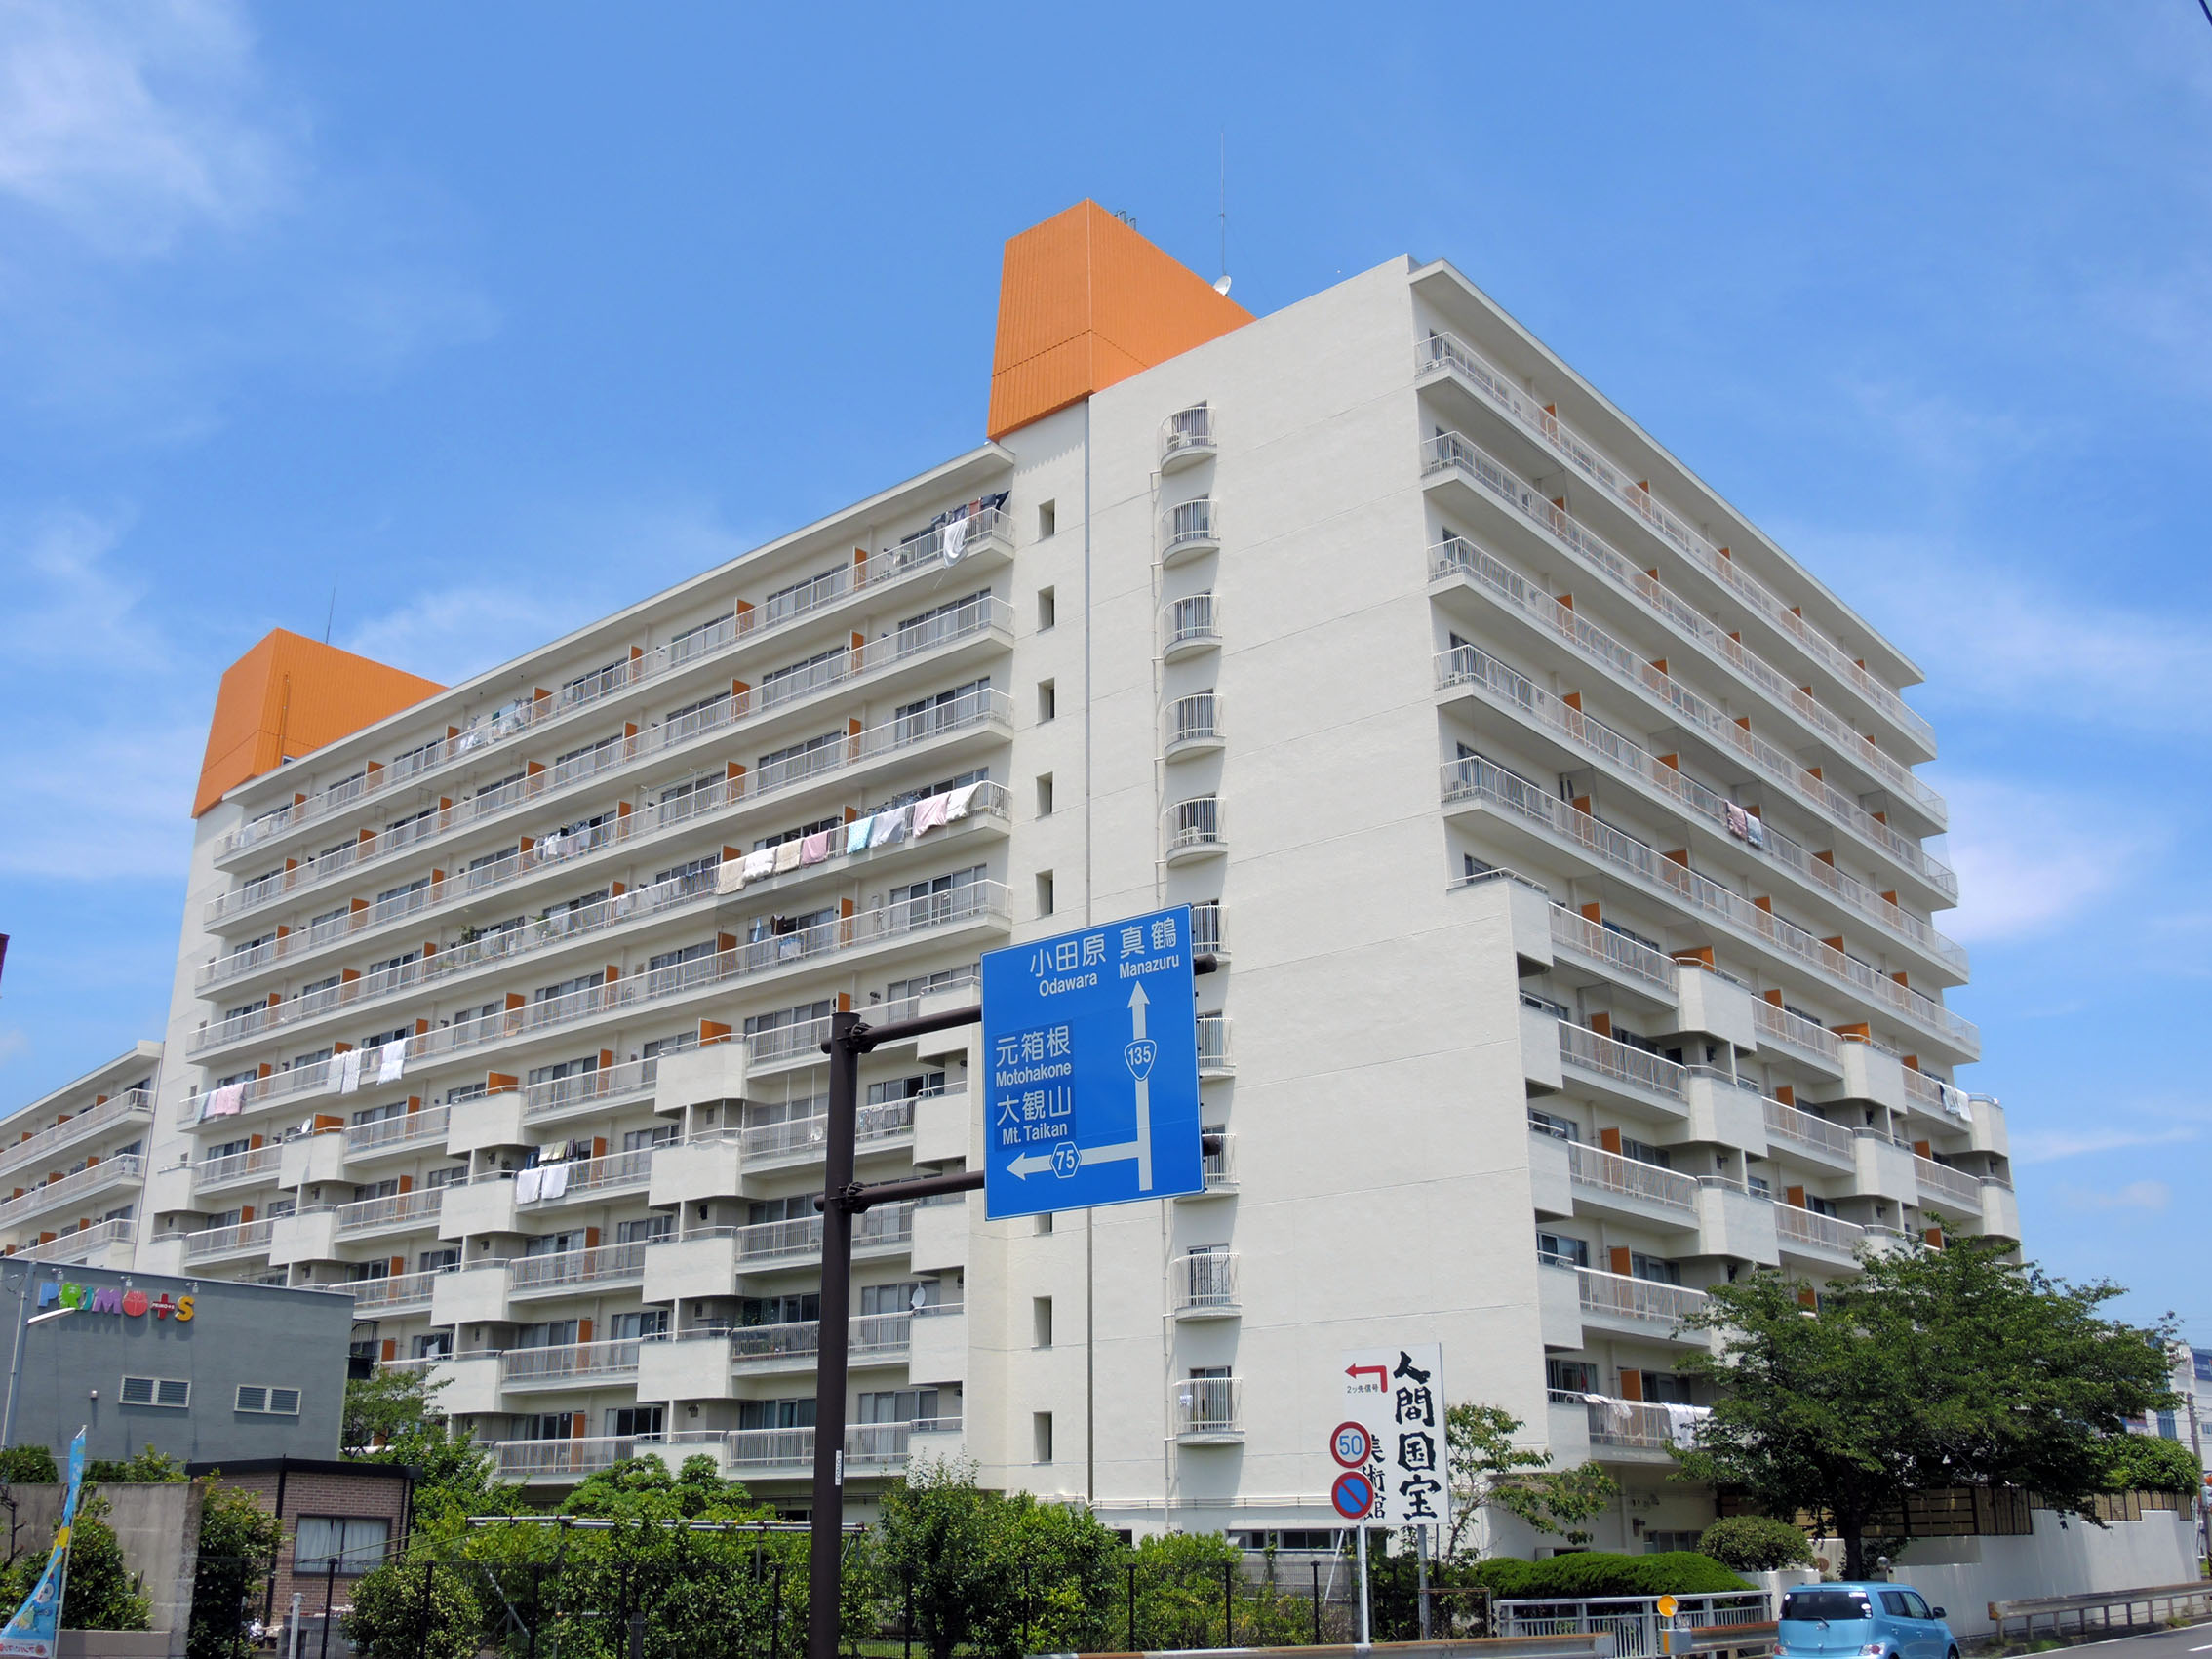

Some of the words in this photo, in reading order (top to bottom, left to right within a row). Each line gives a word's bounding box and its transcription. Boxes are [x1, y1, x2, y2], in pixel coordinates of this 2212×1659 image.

[1029, 932, 1106, 978] 小田原
[1120, 916, 1177, 959] 真鶴
[1039, 971, 1098, 997] Odawara
[1119, 954, 1180, 979] Manazuru
[995, 1025, 1071, 1069] 元箱根
[1128, 1045, 1152, 1066] 135
[995, 1062, 1072, 1088] Motohakone
[996, 1086, 1072, 1126] 大観山
[1002, 1127, 1022, 1145] Mt.
[1025, 1122, 1068, 1142] Taikan
[1056, 1149, 1076, 1171] 75
[1339, 1435, 1363, 1456] 50
[1393, 1350, 1442, 1521] 人間国宝
